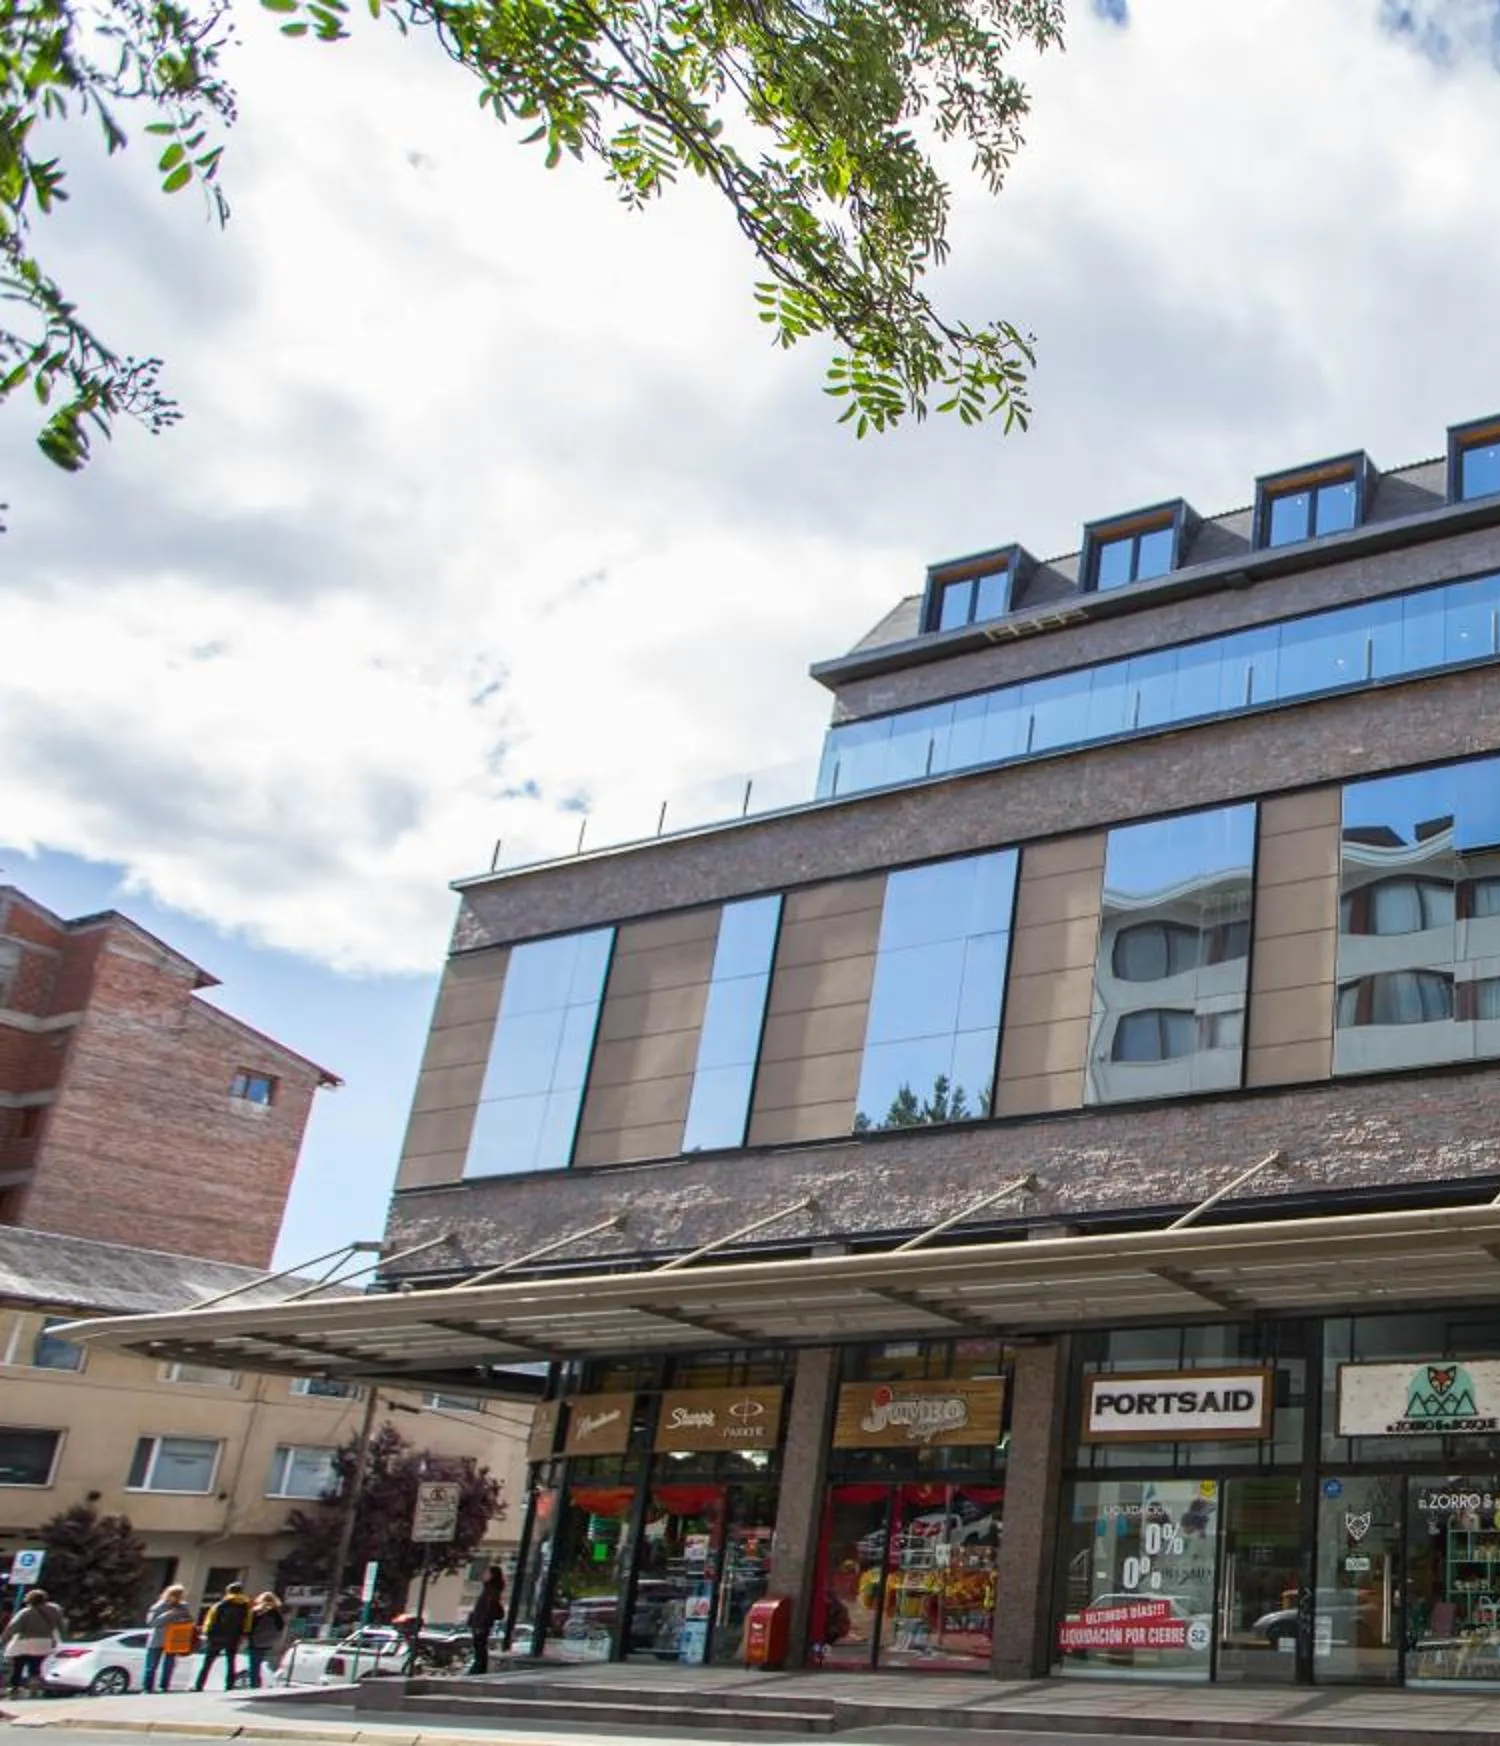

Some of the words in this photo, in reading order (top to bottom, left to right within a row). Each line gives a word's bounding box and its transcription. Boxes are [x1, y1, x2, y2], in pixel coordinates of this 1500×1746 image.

[1095, 1390, 1255, 1415] PORTSAID
[1429, 1494, 1481, 1509] ZORRO
[1125, 1627, 1146, 1644] POR
[1149, 1627, 1185, 1643] CIERRE
